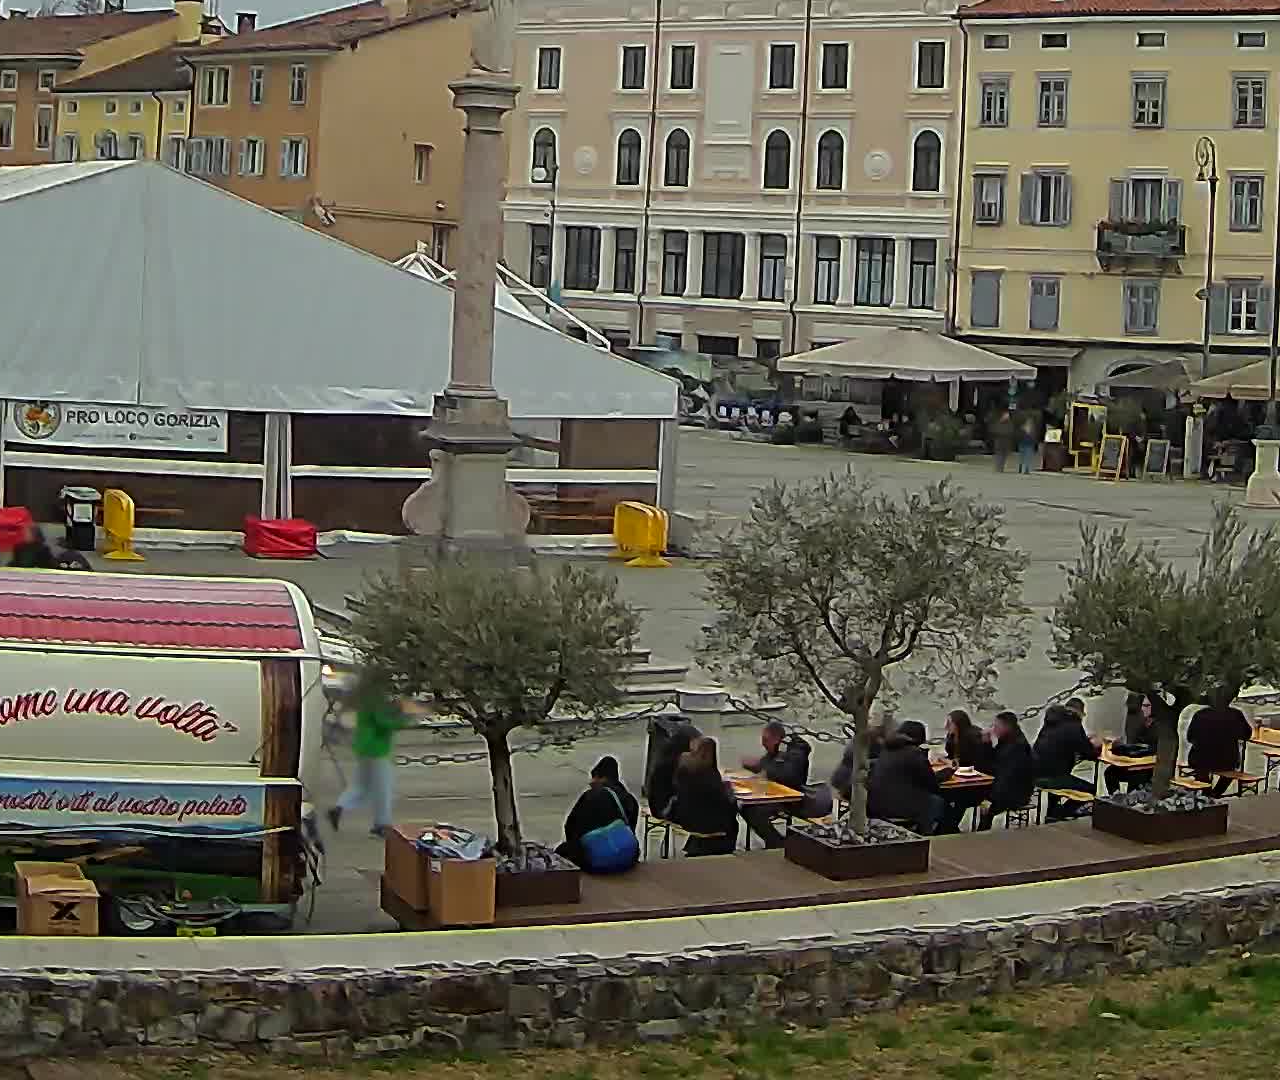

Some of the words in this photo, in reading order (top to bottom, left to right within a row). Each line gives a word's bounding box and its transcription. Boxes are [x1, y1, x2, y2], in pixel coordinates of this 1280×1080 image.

[65, 409, 100, 425] PRO
[104, 410, 150, 427] LOCO
[153, 412, 222, 428] GORIZIA
[64, 688, 130, 716] una
[92, 791, 119, 812] al
[118, 794, 179, 816] vostro
[177, 794, 248, 822] palato
